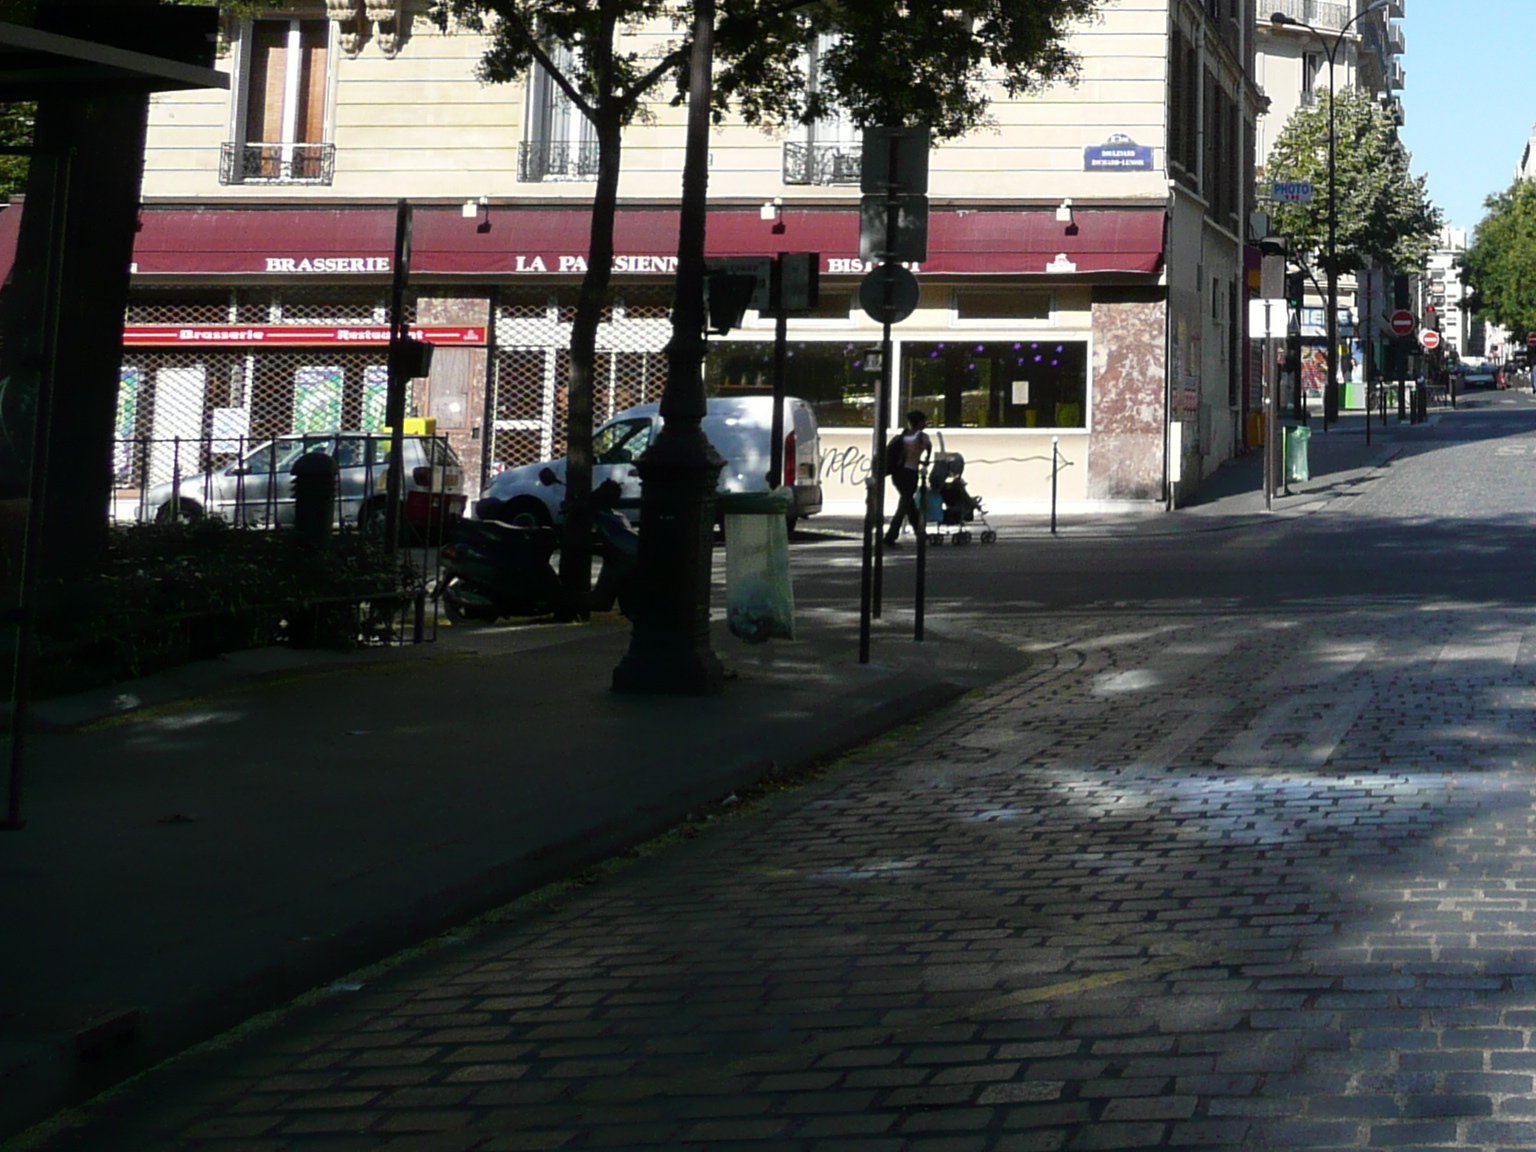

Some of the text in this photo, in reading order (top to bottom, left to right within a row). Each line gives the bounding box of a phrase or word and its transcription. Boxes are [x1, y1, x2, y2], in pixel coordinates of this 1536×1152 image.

[1274, 183, 1310, 195] PHOTO
[265, 256, 391, 272] BRASSERIE
[515, 256, 547, 272] LA
[179, 329, 265, 341] Brasserie
